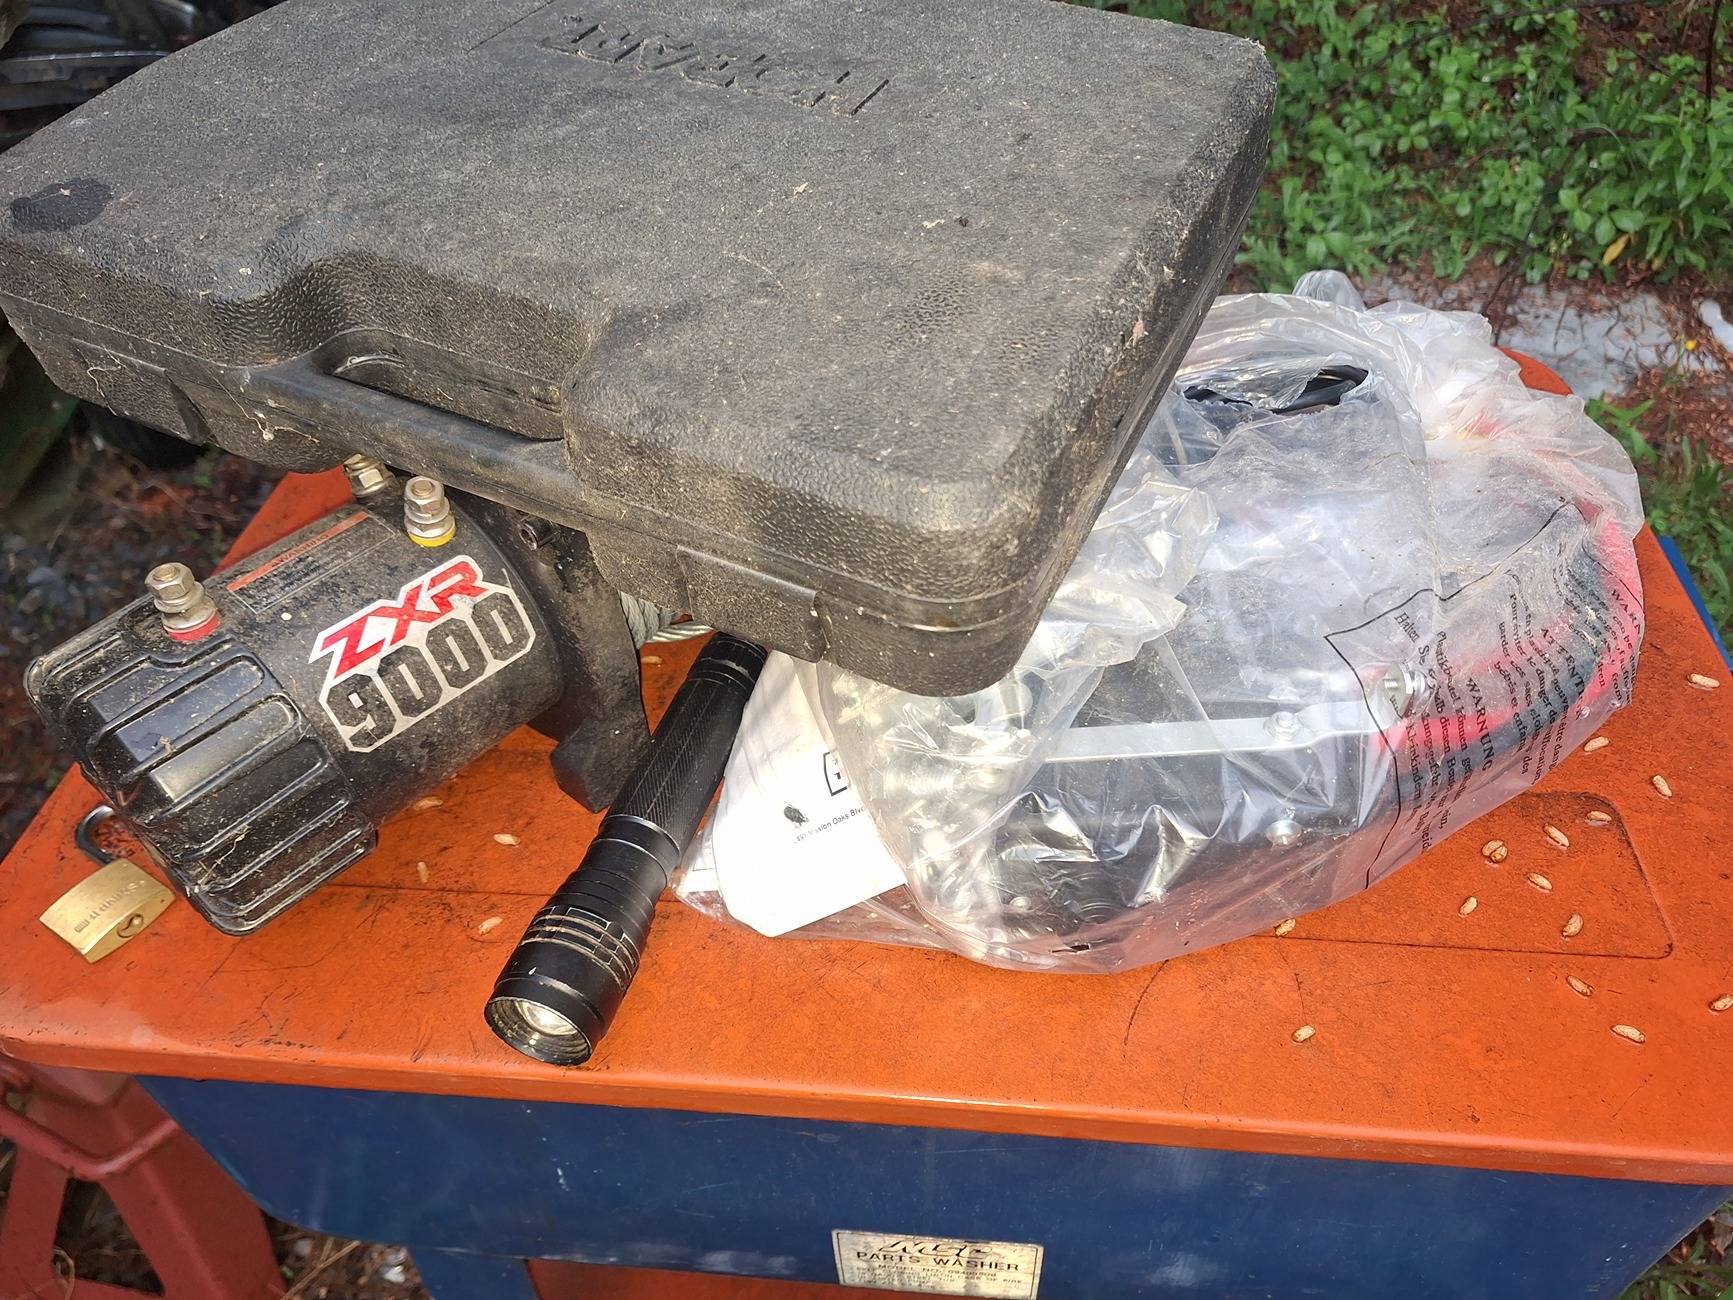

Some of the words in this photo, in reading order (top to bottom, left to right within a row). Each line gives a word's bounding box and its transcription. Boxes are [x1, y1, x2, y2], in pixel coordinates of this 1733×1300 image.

[319, 560, 489, 680] ZXR
[325, 591, 532, 749] 9000
[1393, 613, 1420, 642] Halten
[1440, 717, 1451, 753] diesen
[1535, 669, 1552, 708] danger
[1611, 672, 1622, 700] from
[1524, 681, 1532, 706] sacs
[1464, 677, 1494, 770] WARNUNG
[832, 813, 849, 825] Oaks
[856, 1251, 921, 1263] PARTS
[933, 1258, 1020, 1271] WASHER
